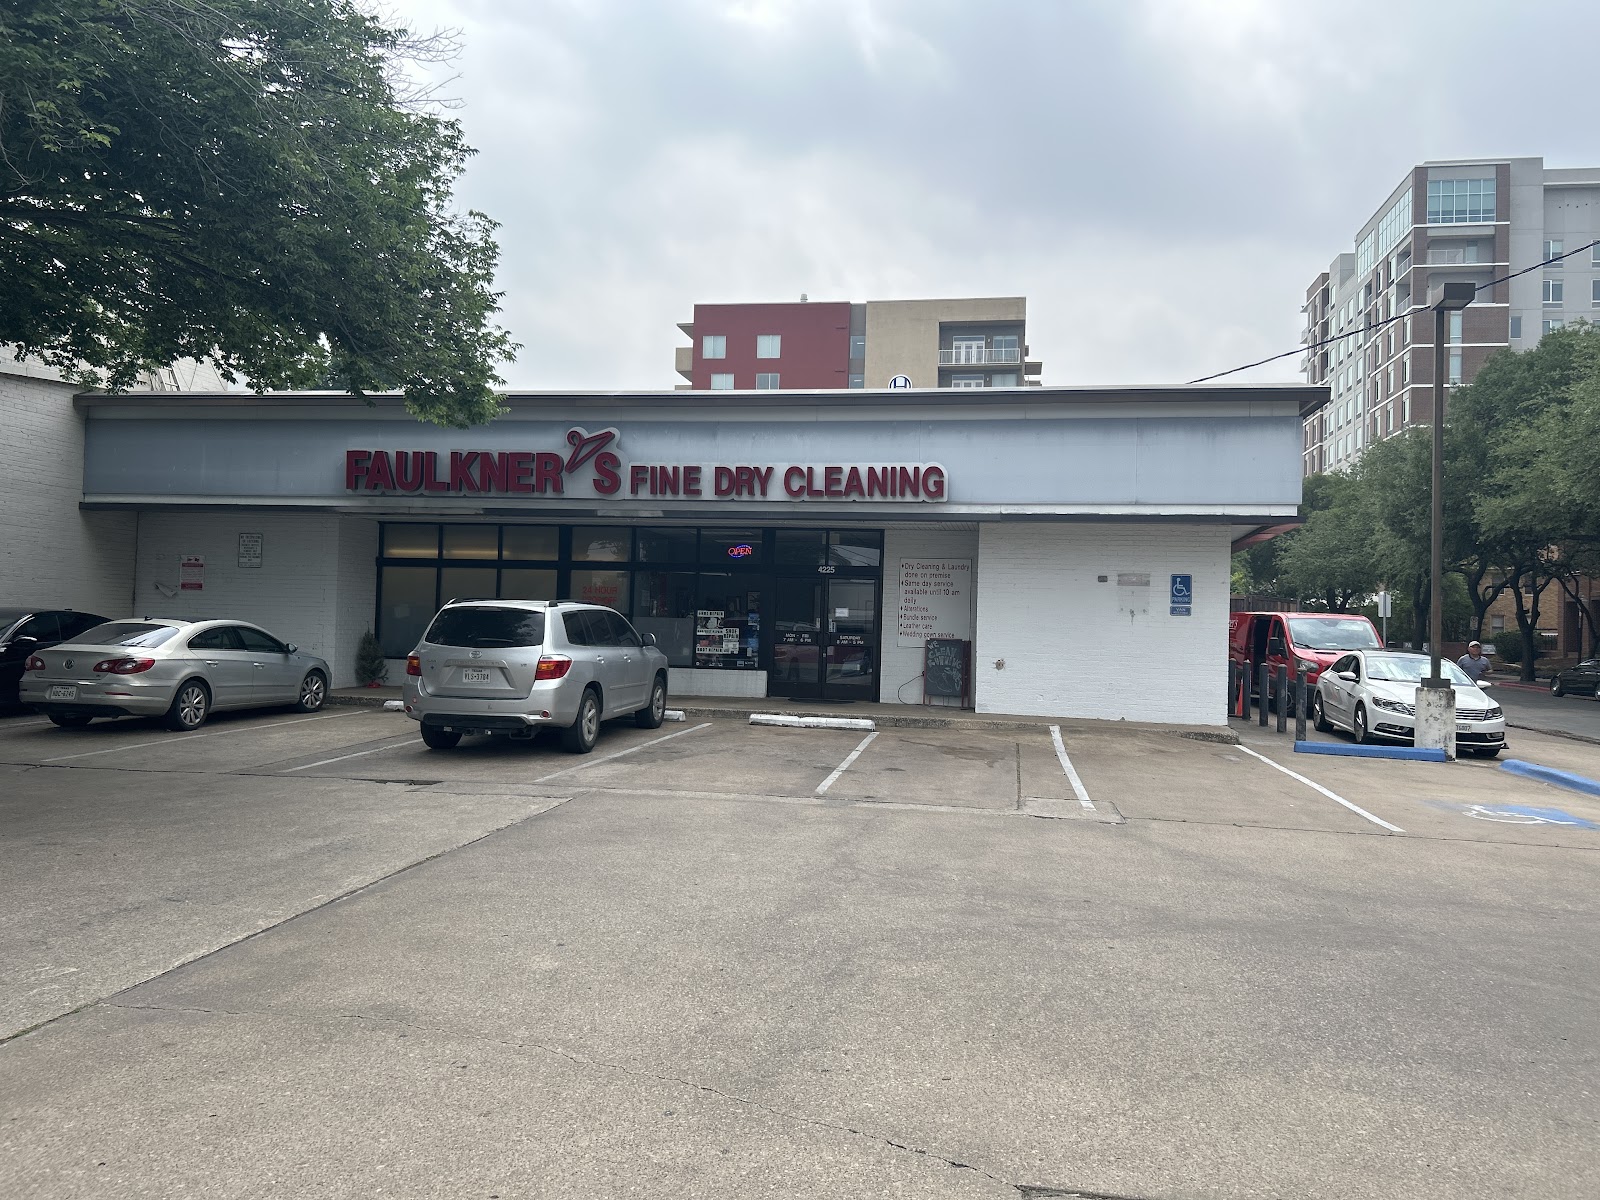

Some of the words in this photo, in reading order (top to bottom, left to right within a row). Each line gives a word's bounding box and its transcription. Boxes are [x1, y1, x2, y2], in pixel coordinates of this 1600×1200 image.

[630, 465, 702, 496] FINE
[714, 465, 774, 497] DRY
[783, 465, 945, 498] CLEANING
[728, 546, 752, 555] OPEN
[818, 565, 835, 573] 4225
[916, 563, 940, 571] Cleaning
[948, 563, 969, 571] Laundry
[595, 586, 618, 594] HOUR
[928, 640, 939, 649] WE
[928, 647, 957, 659] CLEAN
[927, 656, 962, 669] RUNNING
[944, 667, 962, 691] SHOES
